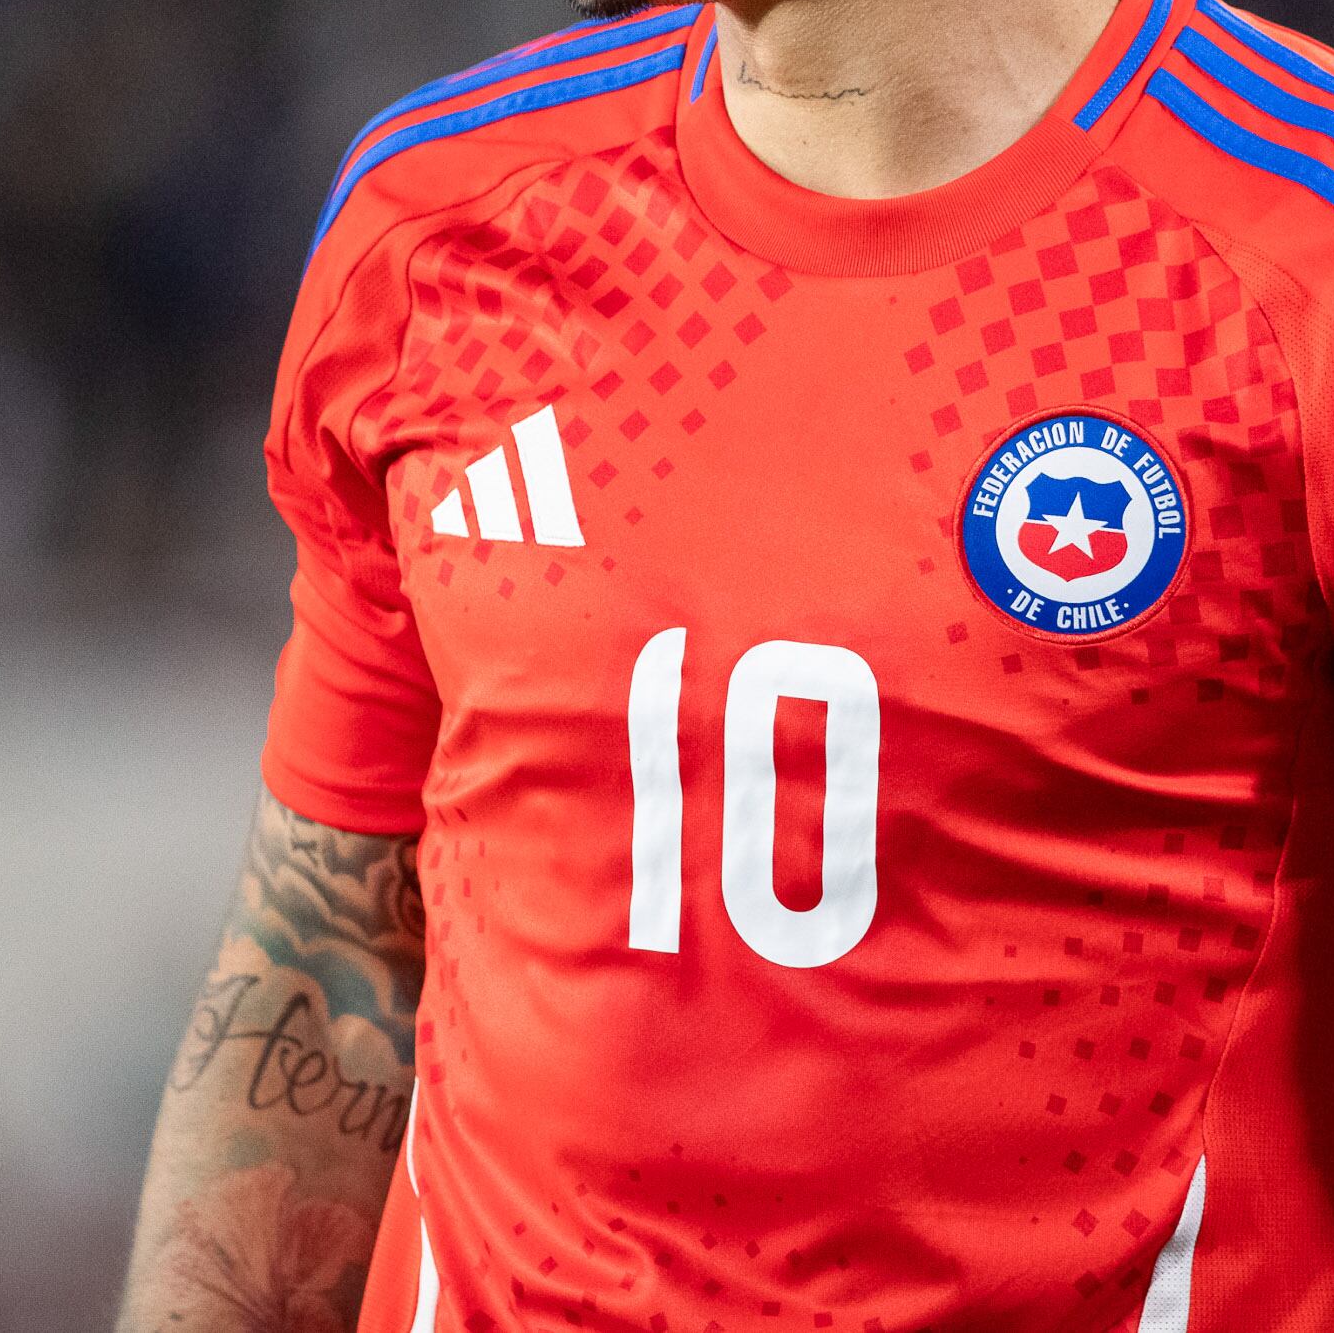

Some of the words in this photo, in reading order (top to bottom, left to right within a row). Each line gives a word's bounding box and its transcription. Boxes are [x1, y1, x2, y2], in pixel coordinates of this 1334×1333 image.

[972, 421, 1084, 518] FEDERACION
[1100, 426, 1132, 458] DE
[1132, 452, 1181, 539] FUTBOL
[628, 627, 881, 968] 10
